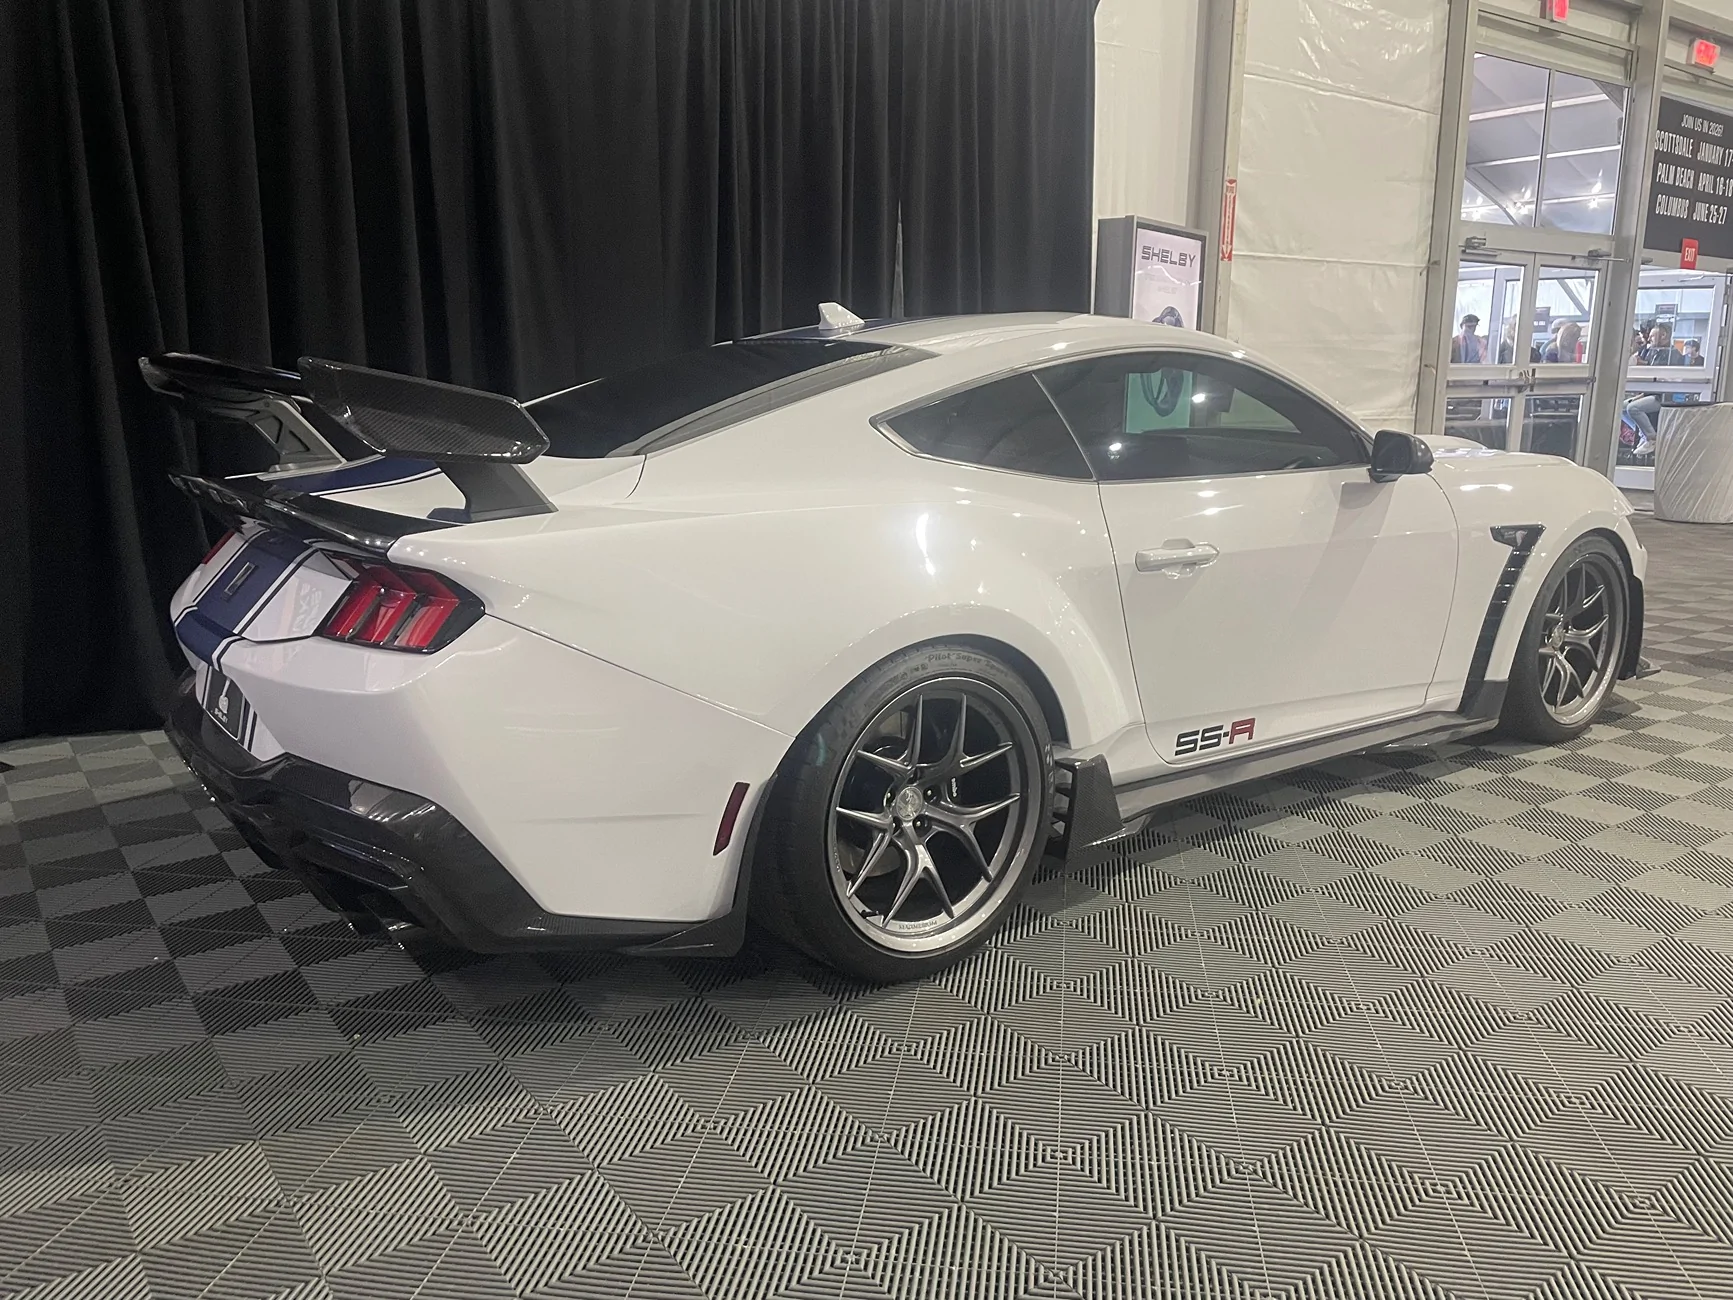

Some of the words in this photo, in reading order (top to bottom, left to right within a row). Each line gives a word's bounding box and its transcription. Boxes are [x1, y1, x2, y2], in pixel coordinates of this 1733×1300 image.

[1681, 114, 1694, 128] JOIN
[1695, 118, 1702, 131] US
[1702, 120, 1708, 132] IN
[1655, 129, 1694, 158] SCOTTSDALE
[1697, 141, 1725, 166] JANUARY
[1656, 162, 1675, 185] PALM
[1675, 166, 1694, 189] BEACH
[1697, 171, 1714, 194] APRIL
[1655, 194, 1690, 219] COLUMBUS
[1693, 202, 1708, 222] JUNE
[1708, 205, 1728, 225] 25-27
[1141, 245, 1196, 268] SHELBY
[1684, 247, 1696, 262] EXIT
[1175, 717, 1256, 756] SS-A
